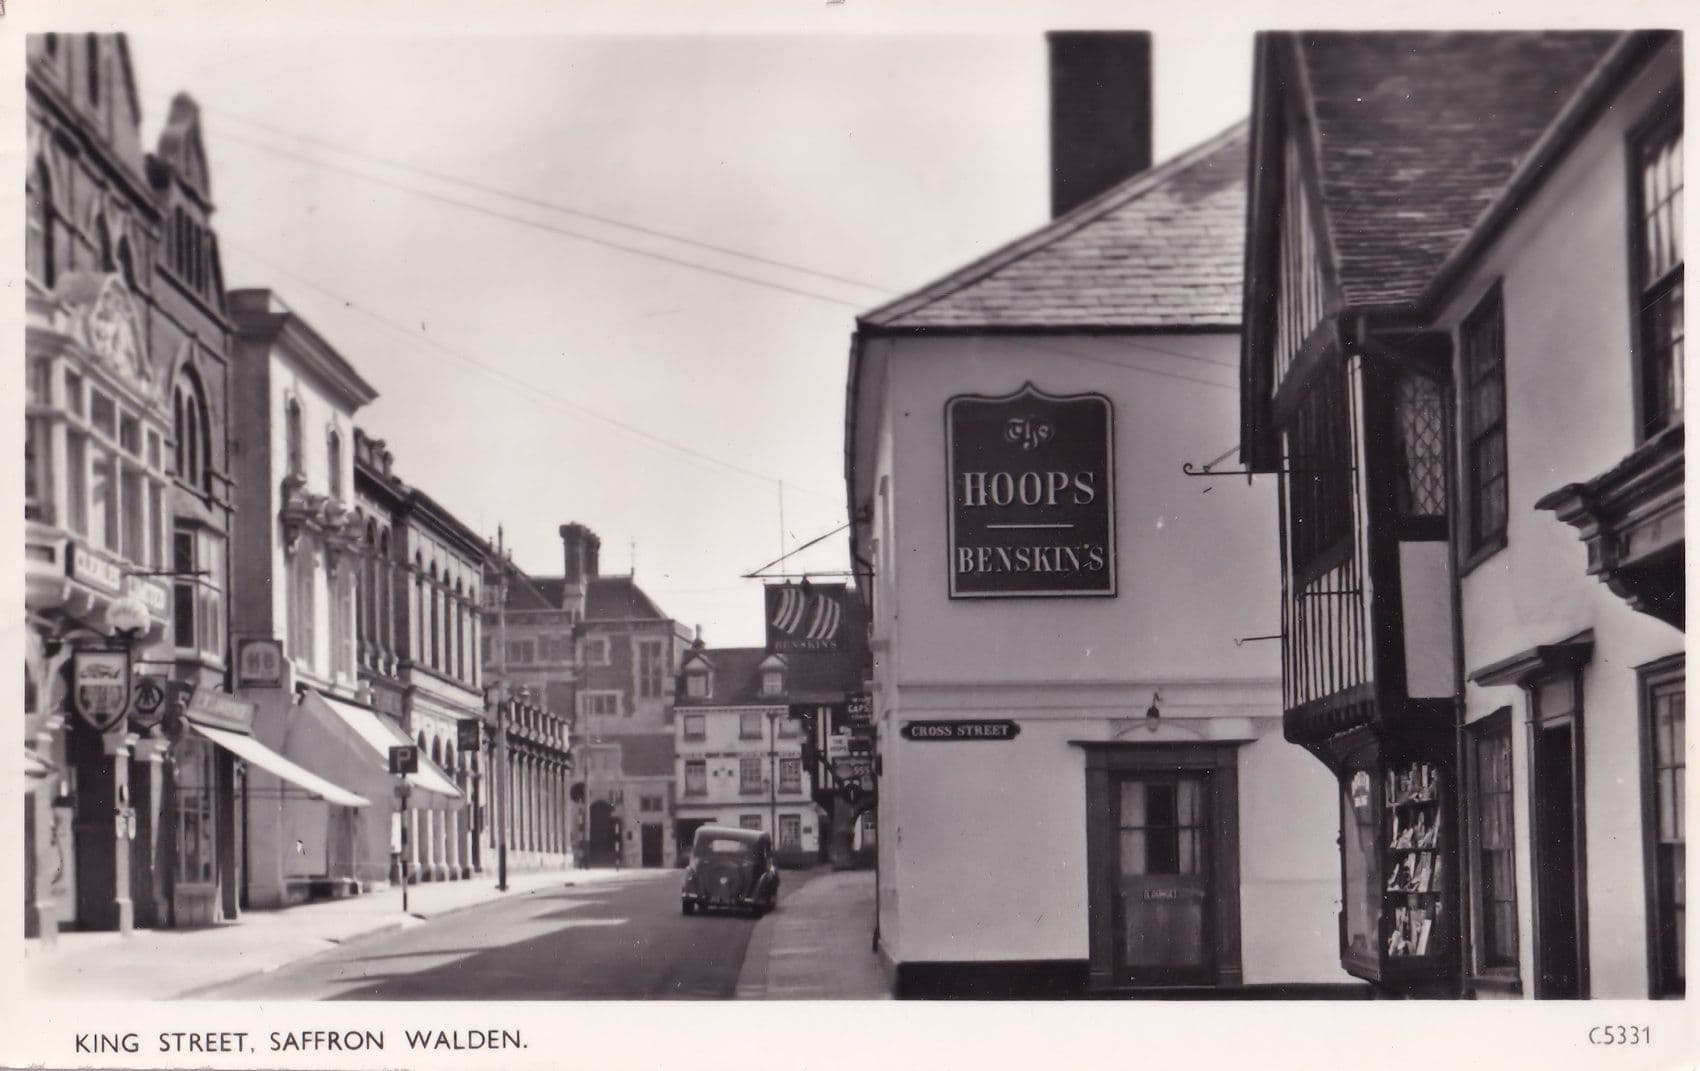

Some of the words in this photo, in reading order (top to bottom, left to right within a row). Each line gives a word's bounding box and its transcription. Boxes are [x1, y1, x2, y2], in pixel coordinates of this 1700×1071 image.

[962, 471, 1096, 506] HOOPS
[957, 543, 1104, 573] BENSKIN'S
[911, 726, 953, 737] CROSS
[956, 724, 1011, 736] STREET
[397, 748, 411, 771] P
